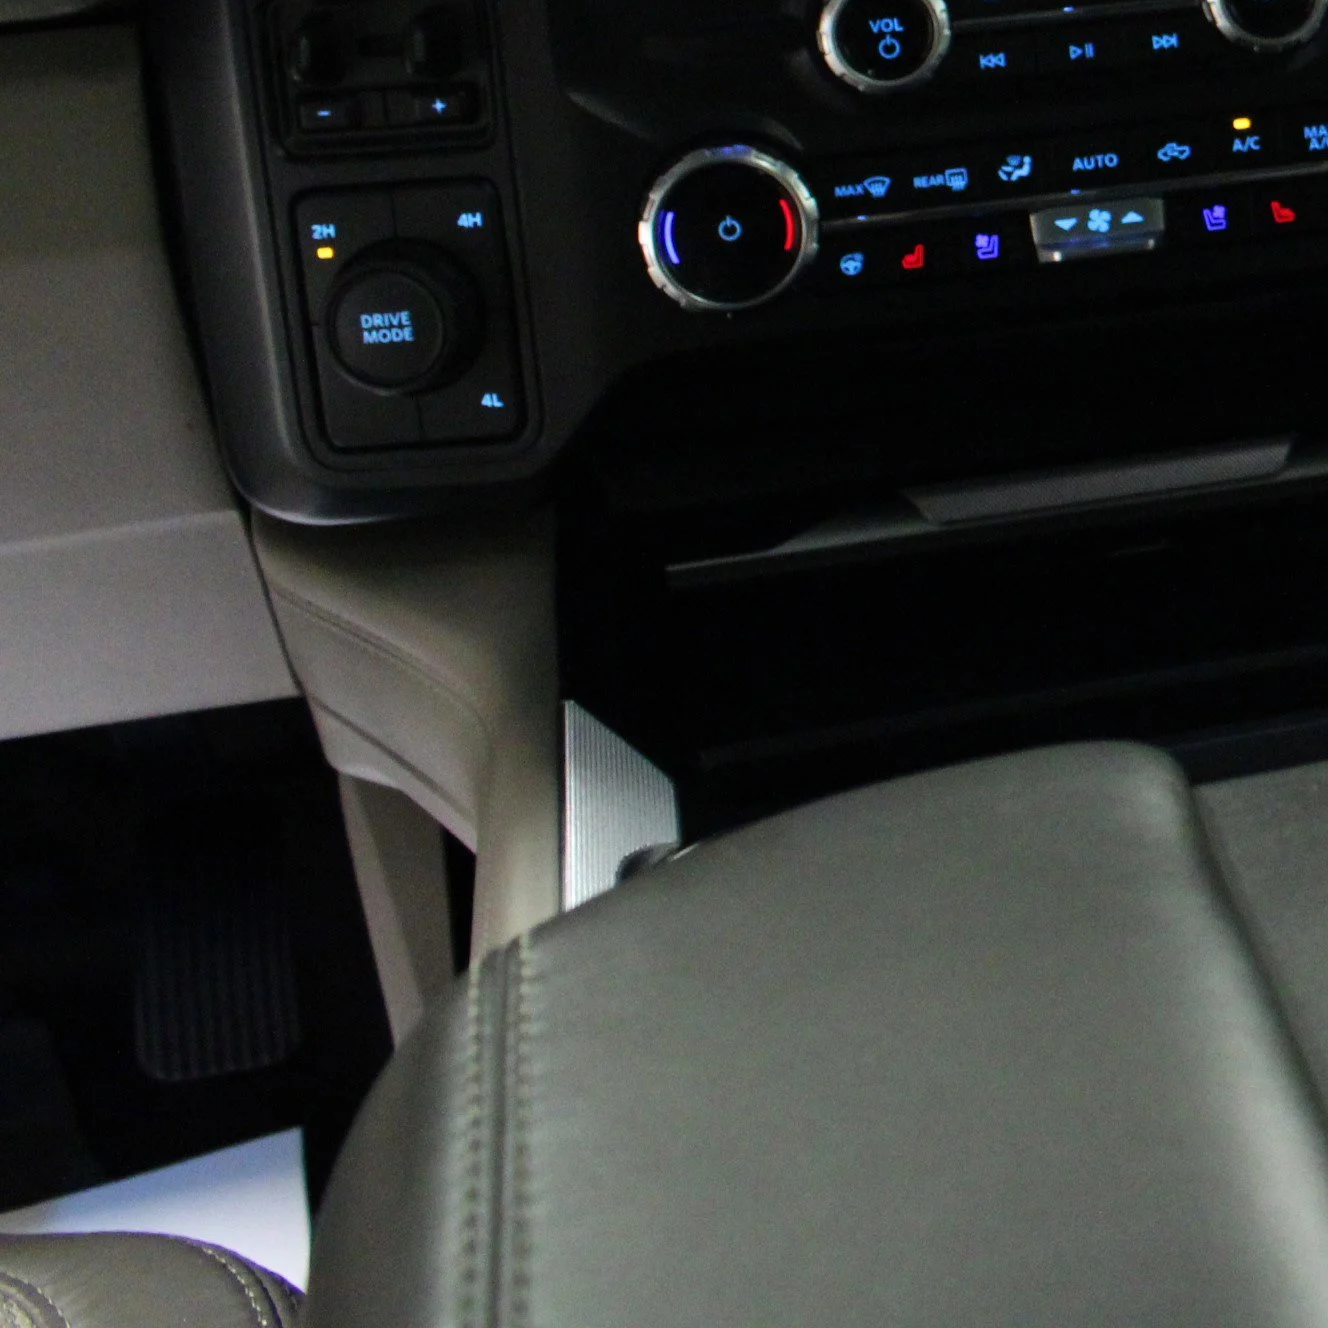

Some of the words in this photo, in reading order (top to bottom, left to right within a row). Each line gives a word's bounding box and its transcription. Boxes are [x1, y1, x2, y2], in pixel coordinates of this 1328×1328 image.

[868, 18, 904, 34] VOL
[1231, 135, 1262, 153] A/C
[1072, 152, 1119, 172] AUTO
[913, 174, 945, 189] REAR
[834, 183, 865, 199] MAX
[457, 212, 483, 228] 4H
[311, 224, 336, 240] 2H
[360, 310, 412, 329] DRIVE
[363, 327, 415, 345] MODE
[481, 393, 505, 408] 4L
